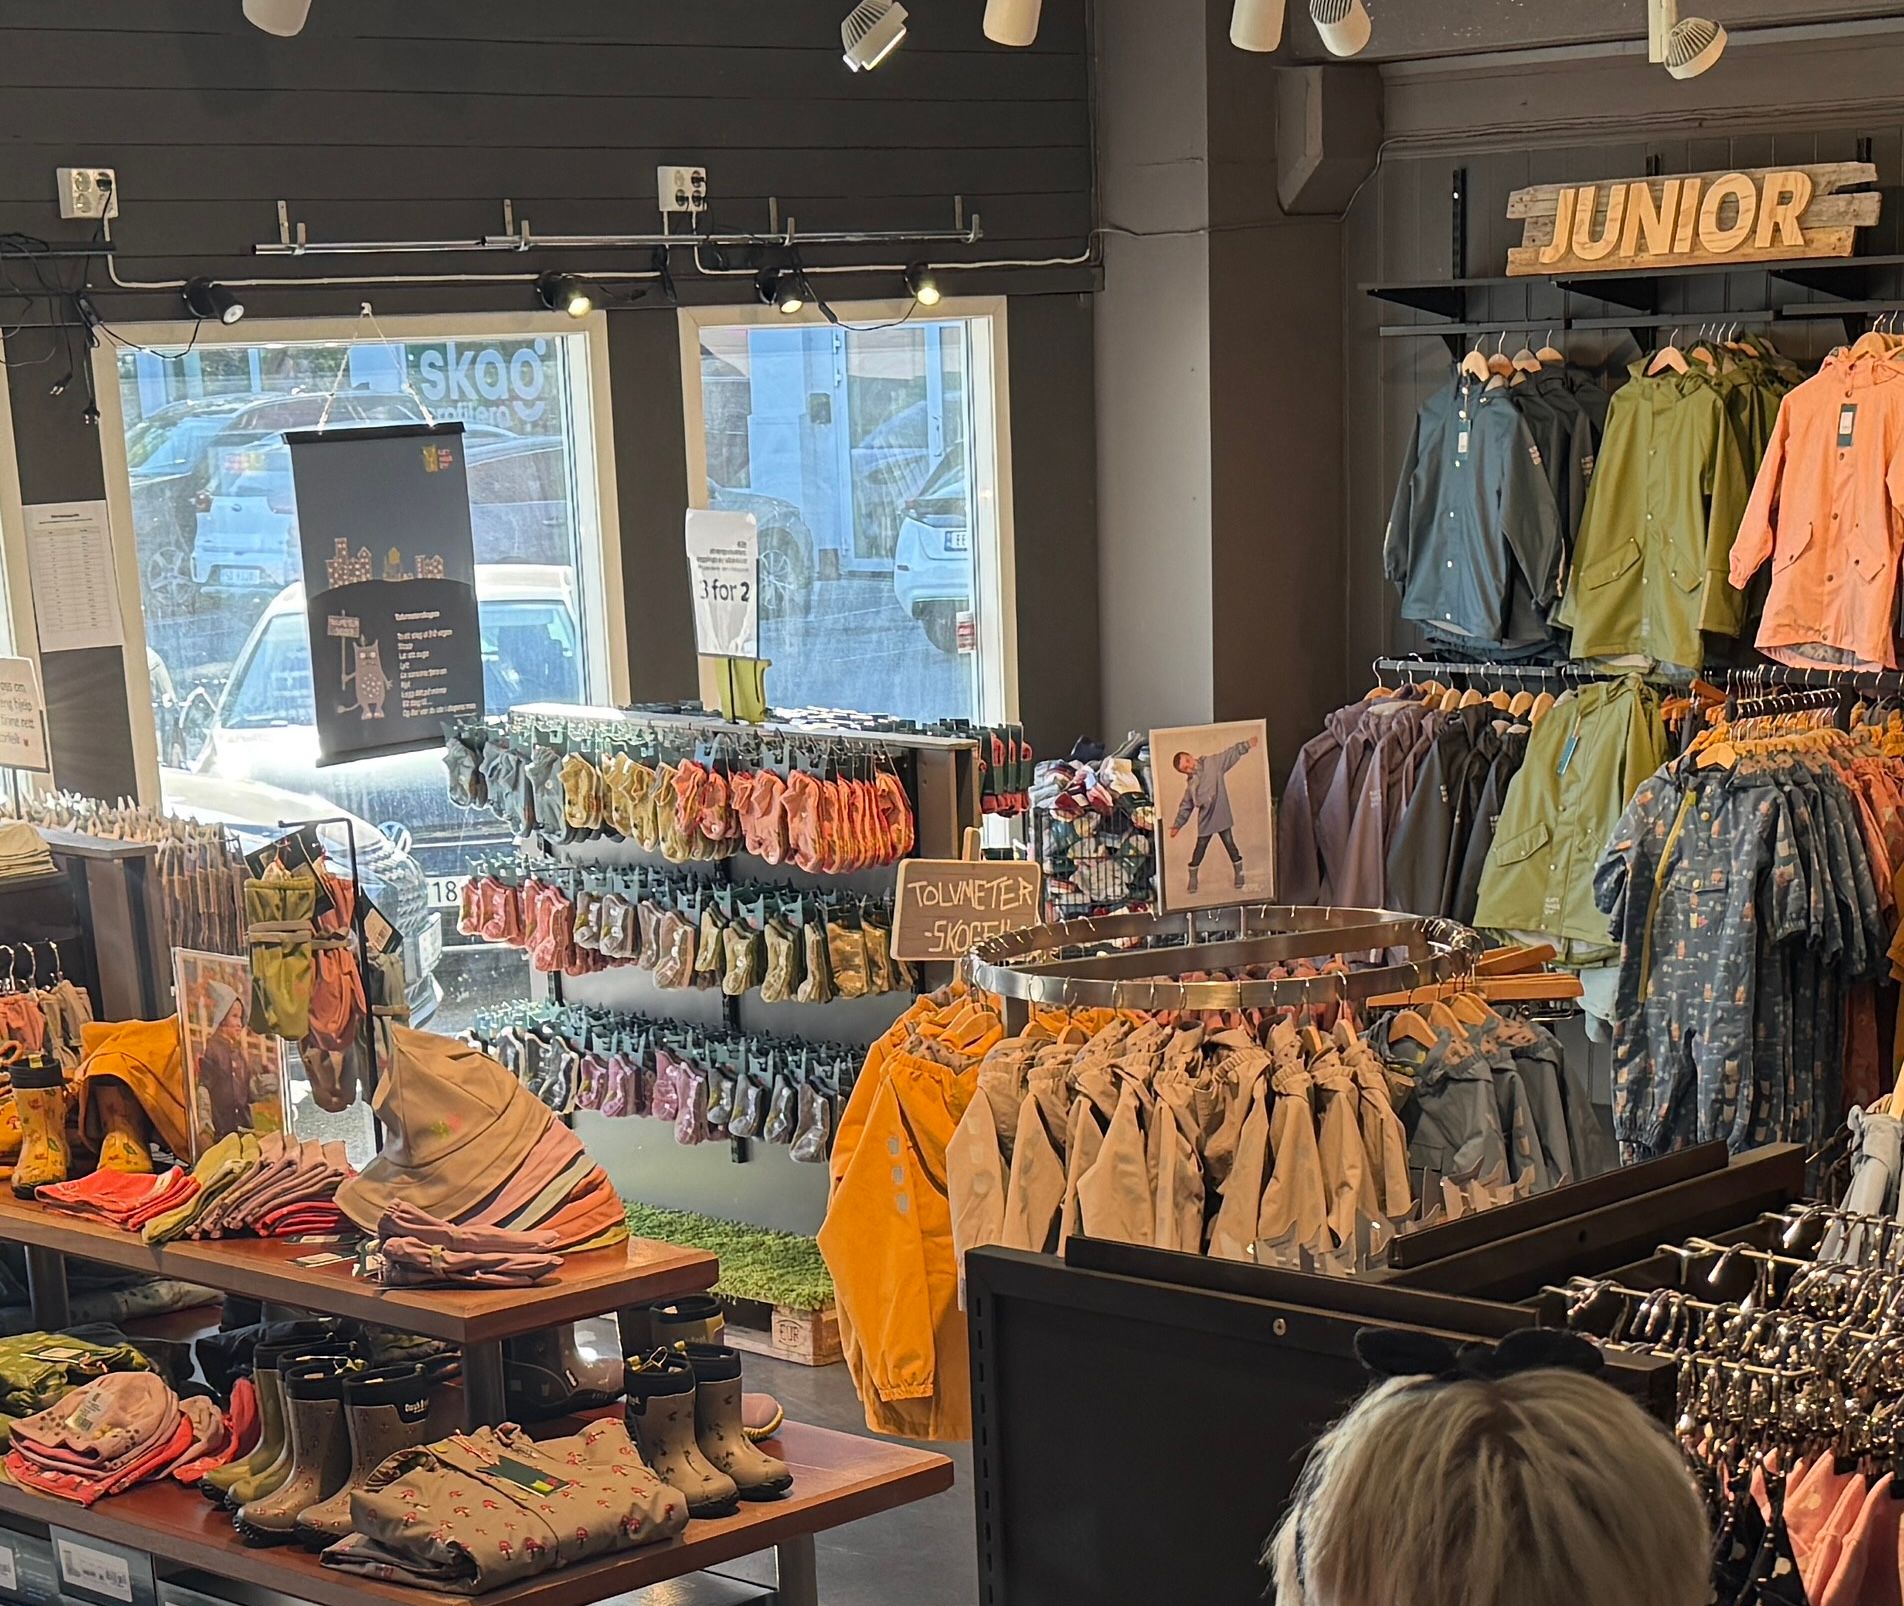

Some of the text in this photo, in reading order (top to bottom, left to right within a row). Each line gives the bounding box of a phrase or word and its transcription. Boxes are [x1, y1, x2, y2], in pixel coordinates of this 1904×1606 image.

[1539, 171, 1813, 264] JUNIOR
[712, 578, 737, 601] for
[741, 581, 750, 602] 2
[907, 876, 1034, 911] TOLVMETER
[779, 1323, 800, 1342] EUR
